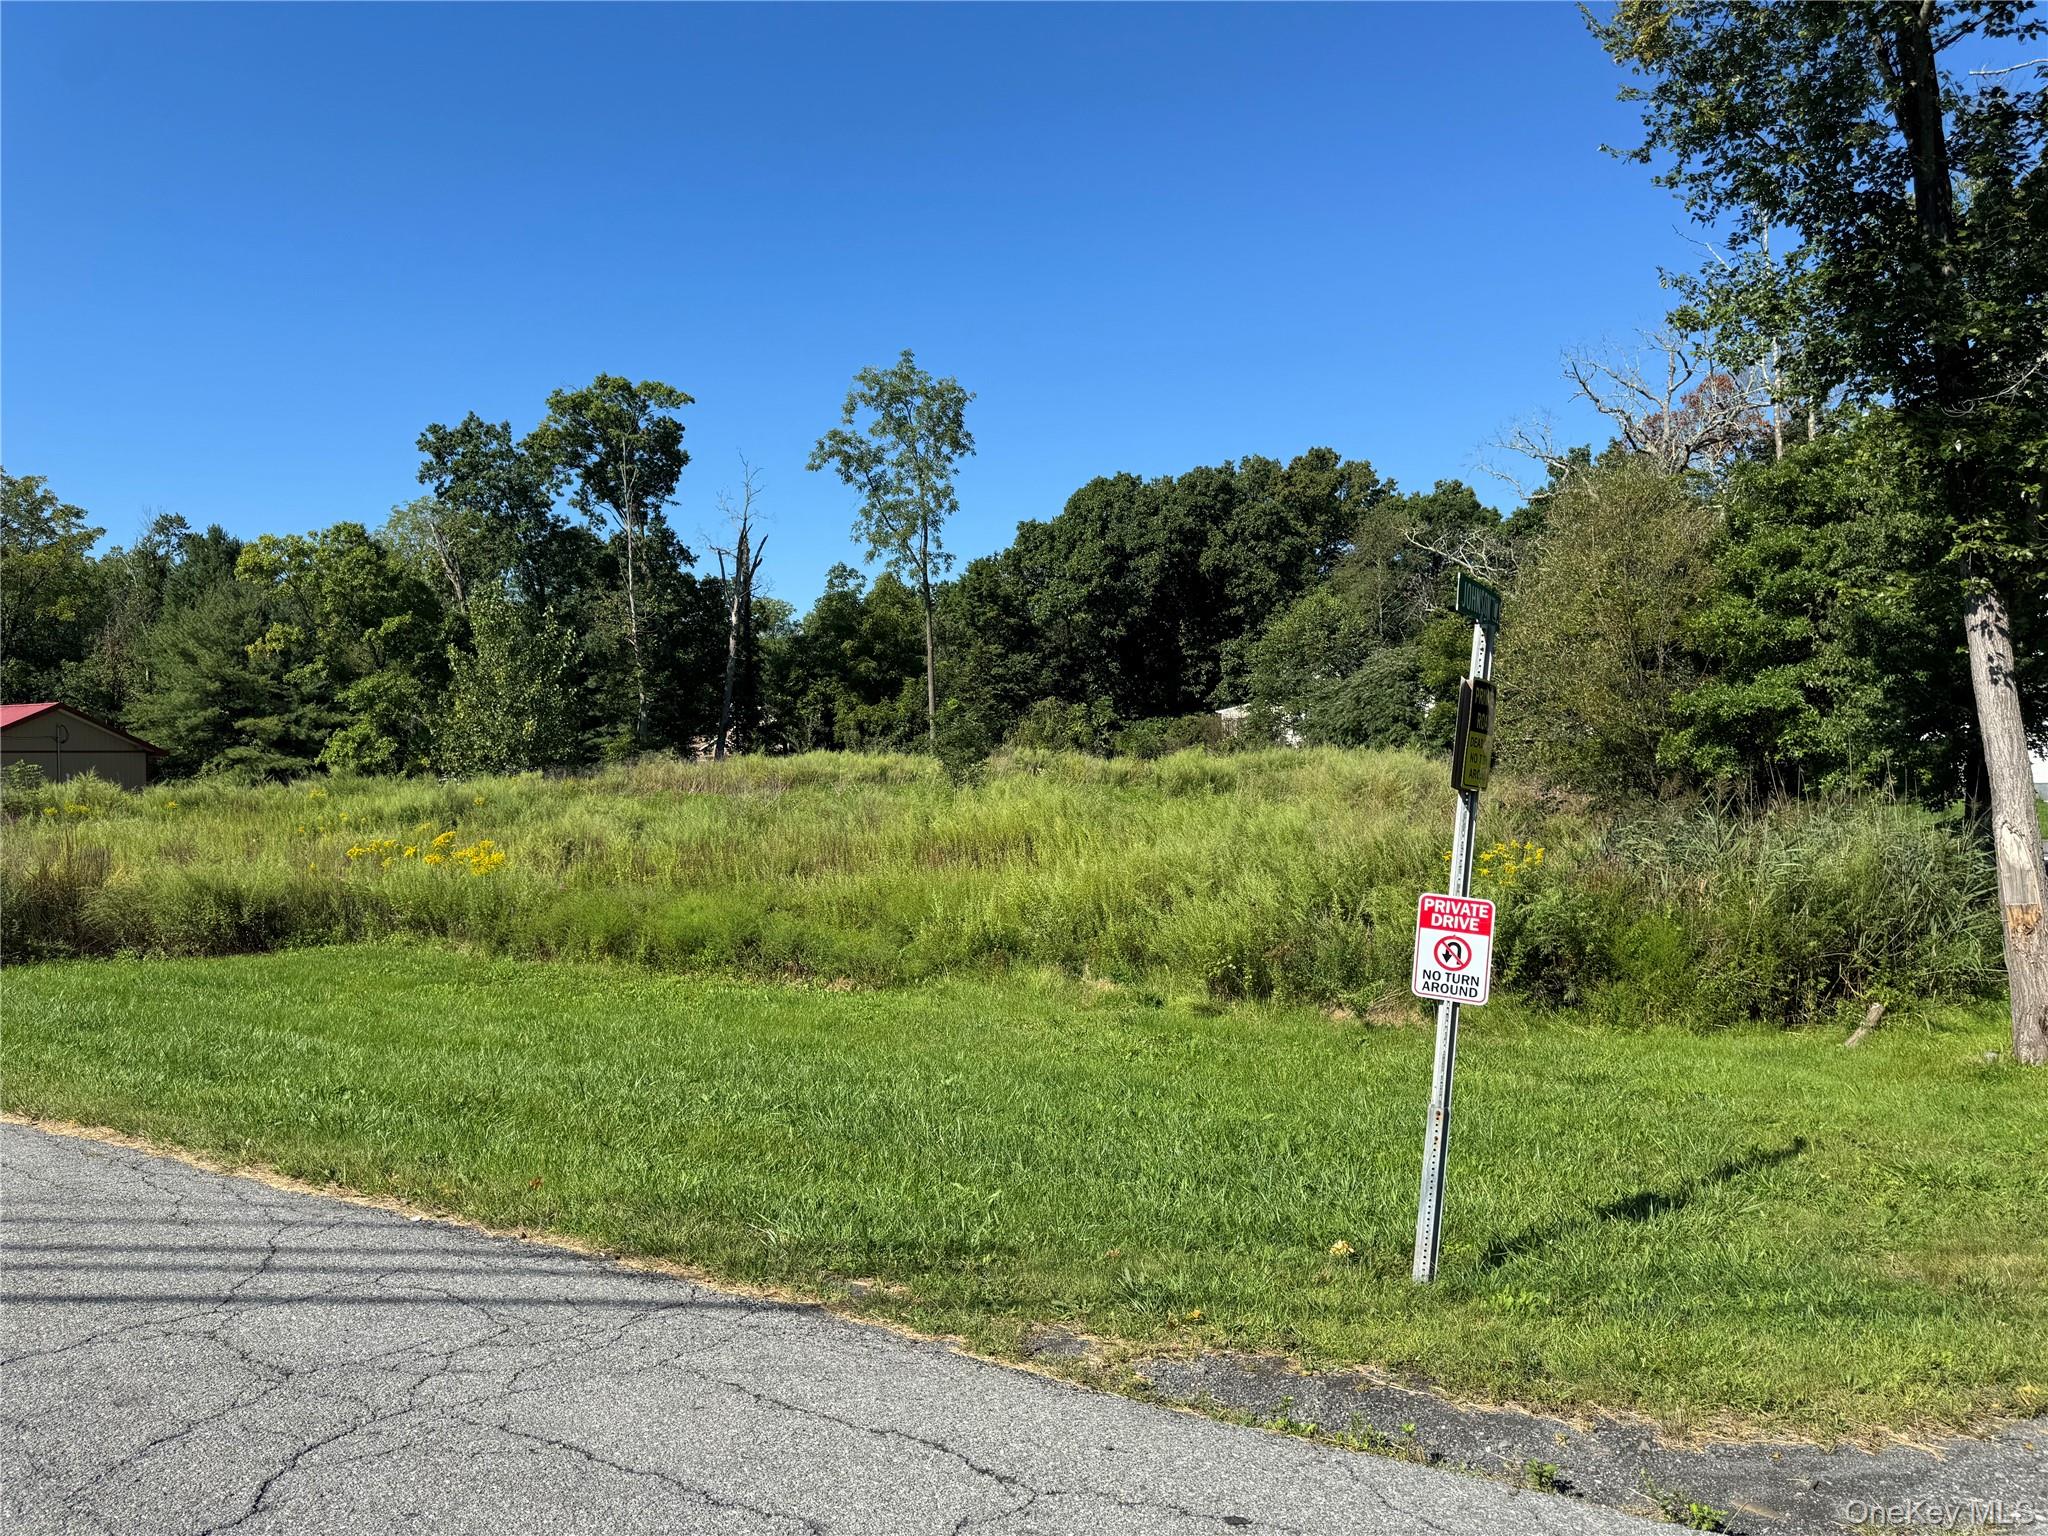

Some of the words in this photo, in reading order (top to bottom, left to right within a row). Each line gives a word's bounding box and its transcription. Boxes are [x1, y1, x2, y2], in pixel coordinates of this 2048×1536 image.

[1424, 898, 1489, 918] PRIVATE
[1431, 913, 1480, 931] DRIVE
[1422, 969, 1441, 981] NO
[1445, 972, 1480, 987] TURN
[1422, 981, 1478, 998] AROUND
